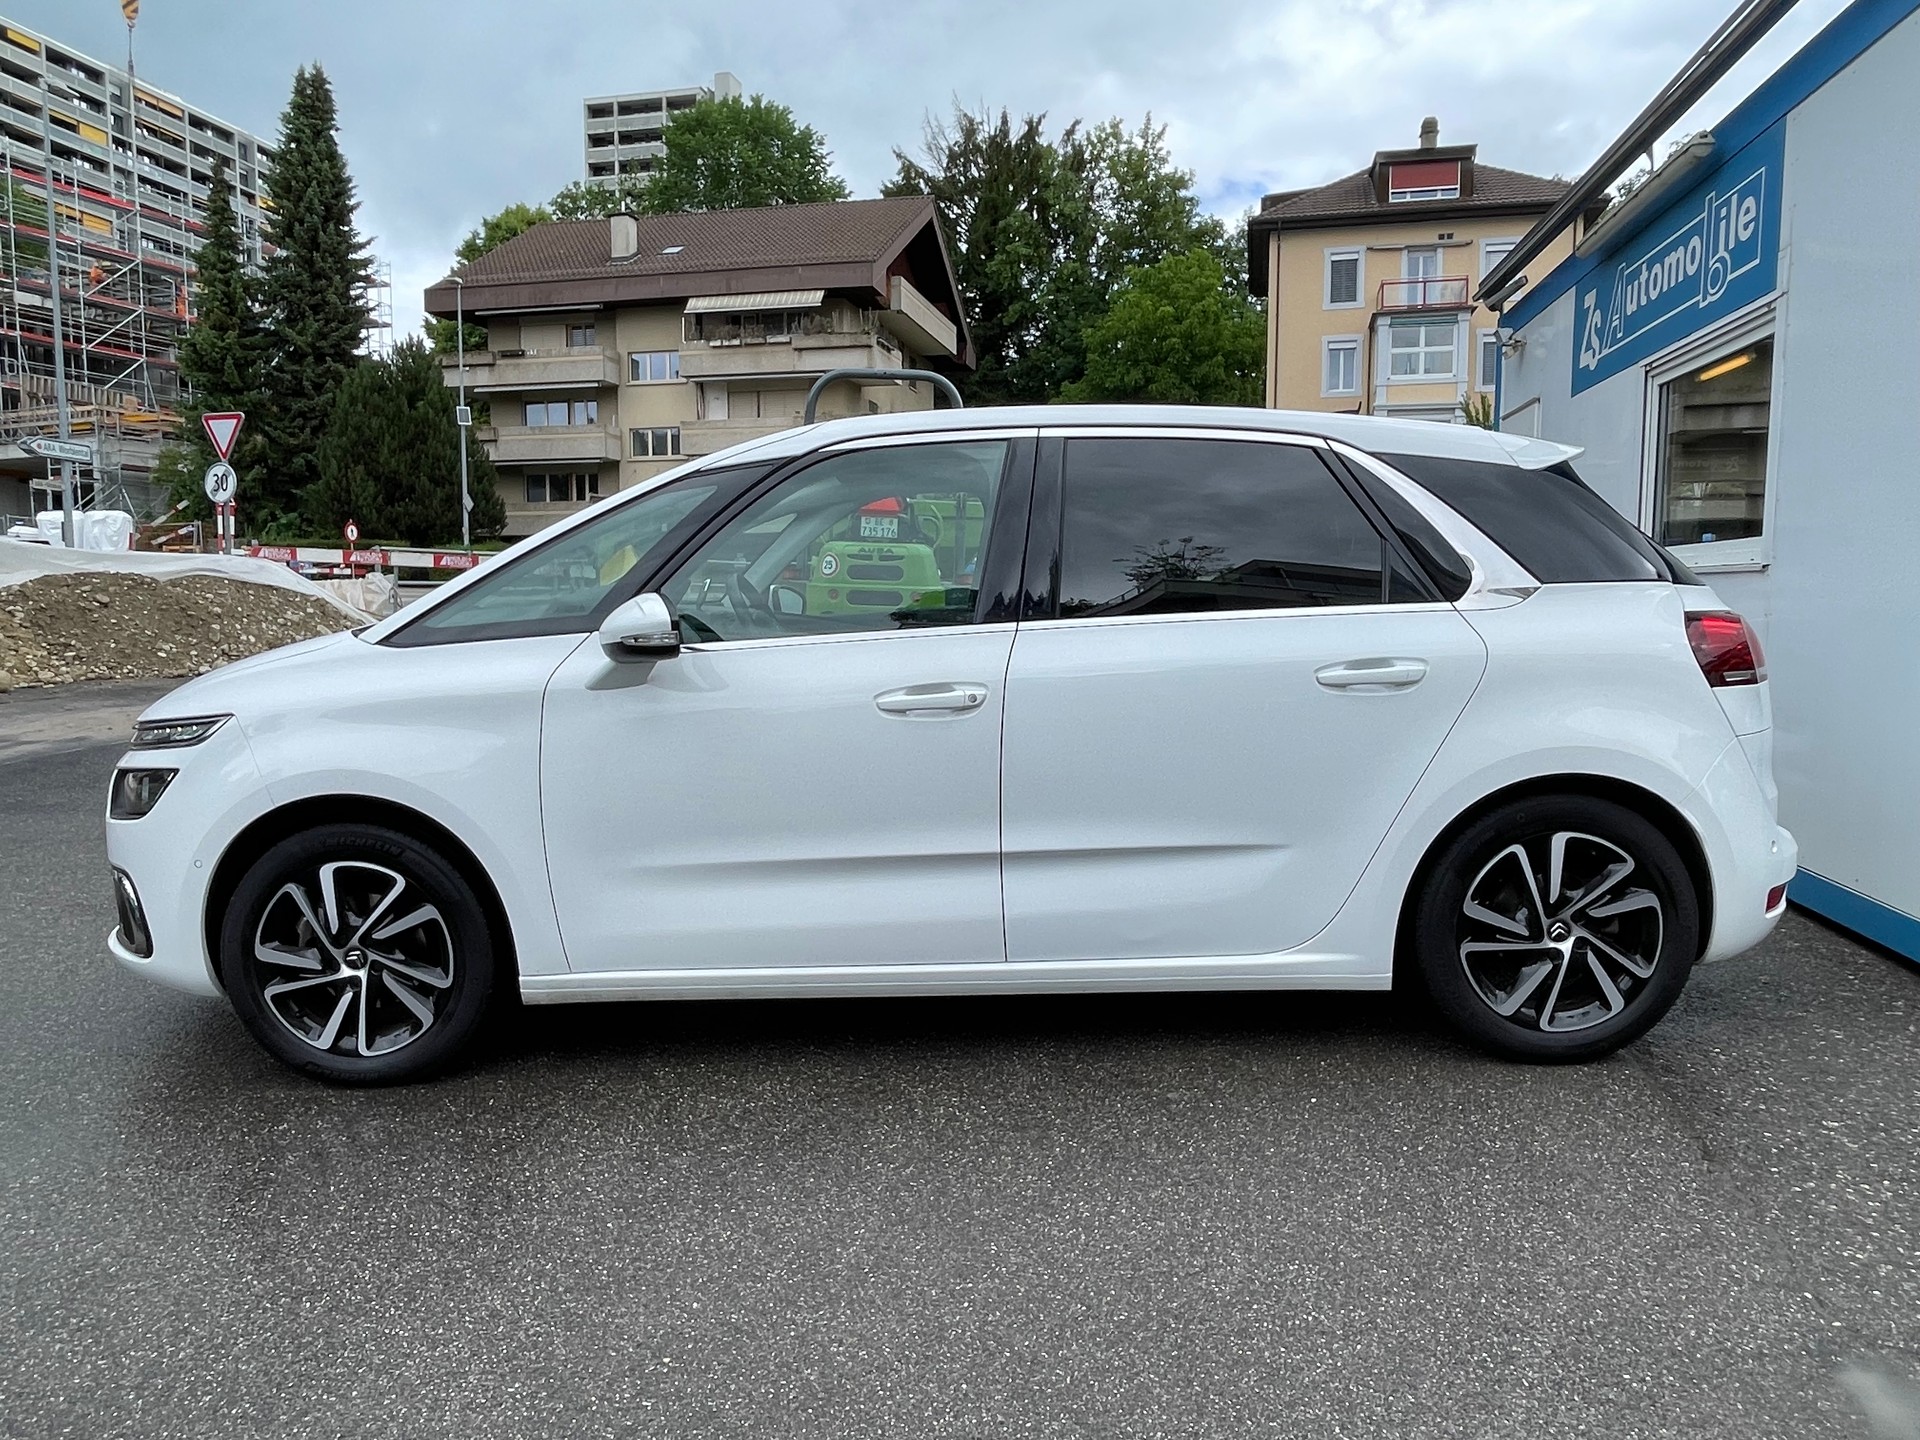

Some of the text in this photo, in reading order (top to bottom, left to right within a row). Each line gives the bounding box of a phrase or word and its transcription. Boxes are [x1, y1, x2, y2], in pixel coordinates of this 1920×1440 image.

[1579, 190, 1757, 371] Zs Automobile
[212, 473, 229, 492] 30
[823, 560, 834, 570] 25
